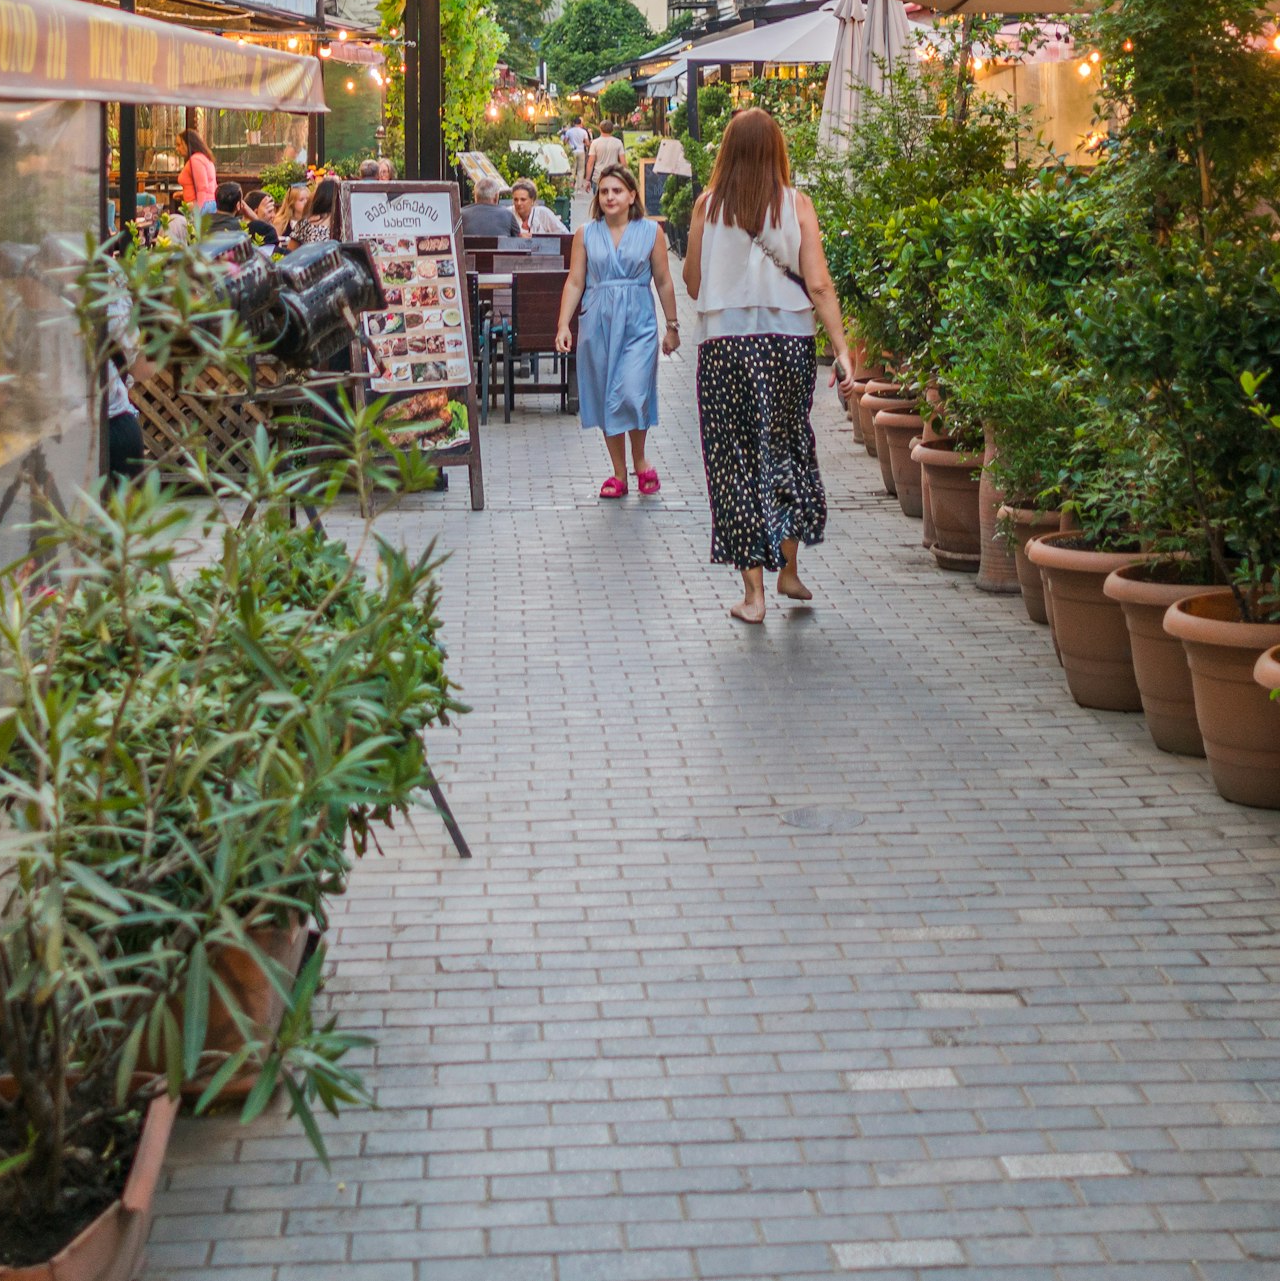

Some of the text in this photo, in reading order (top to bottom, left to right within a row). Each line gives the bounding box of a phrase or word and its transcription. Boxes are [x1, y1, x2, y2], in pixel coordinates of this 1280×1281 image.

[89, 16, 158, 84] WINE SHOP
[384, 217, 421, 228] სახლი
